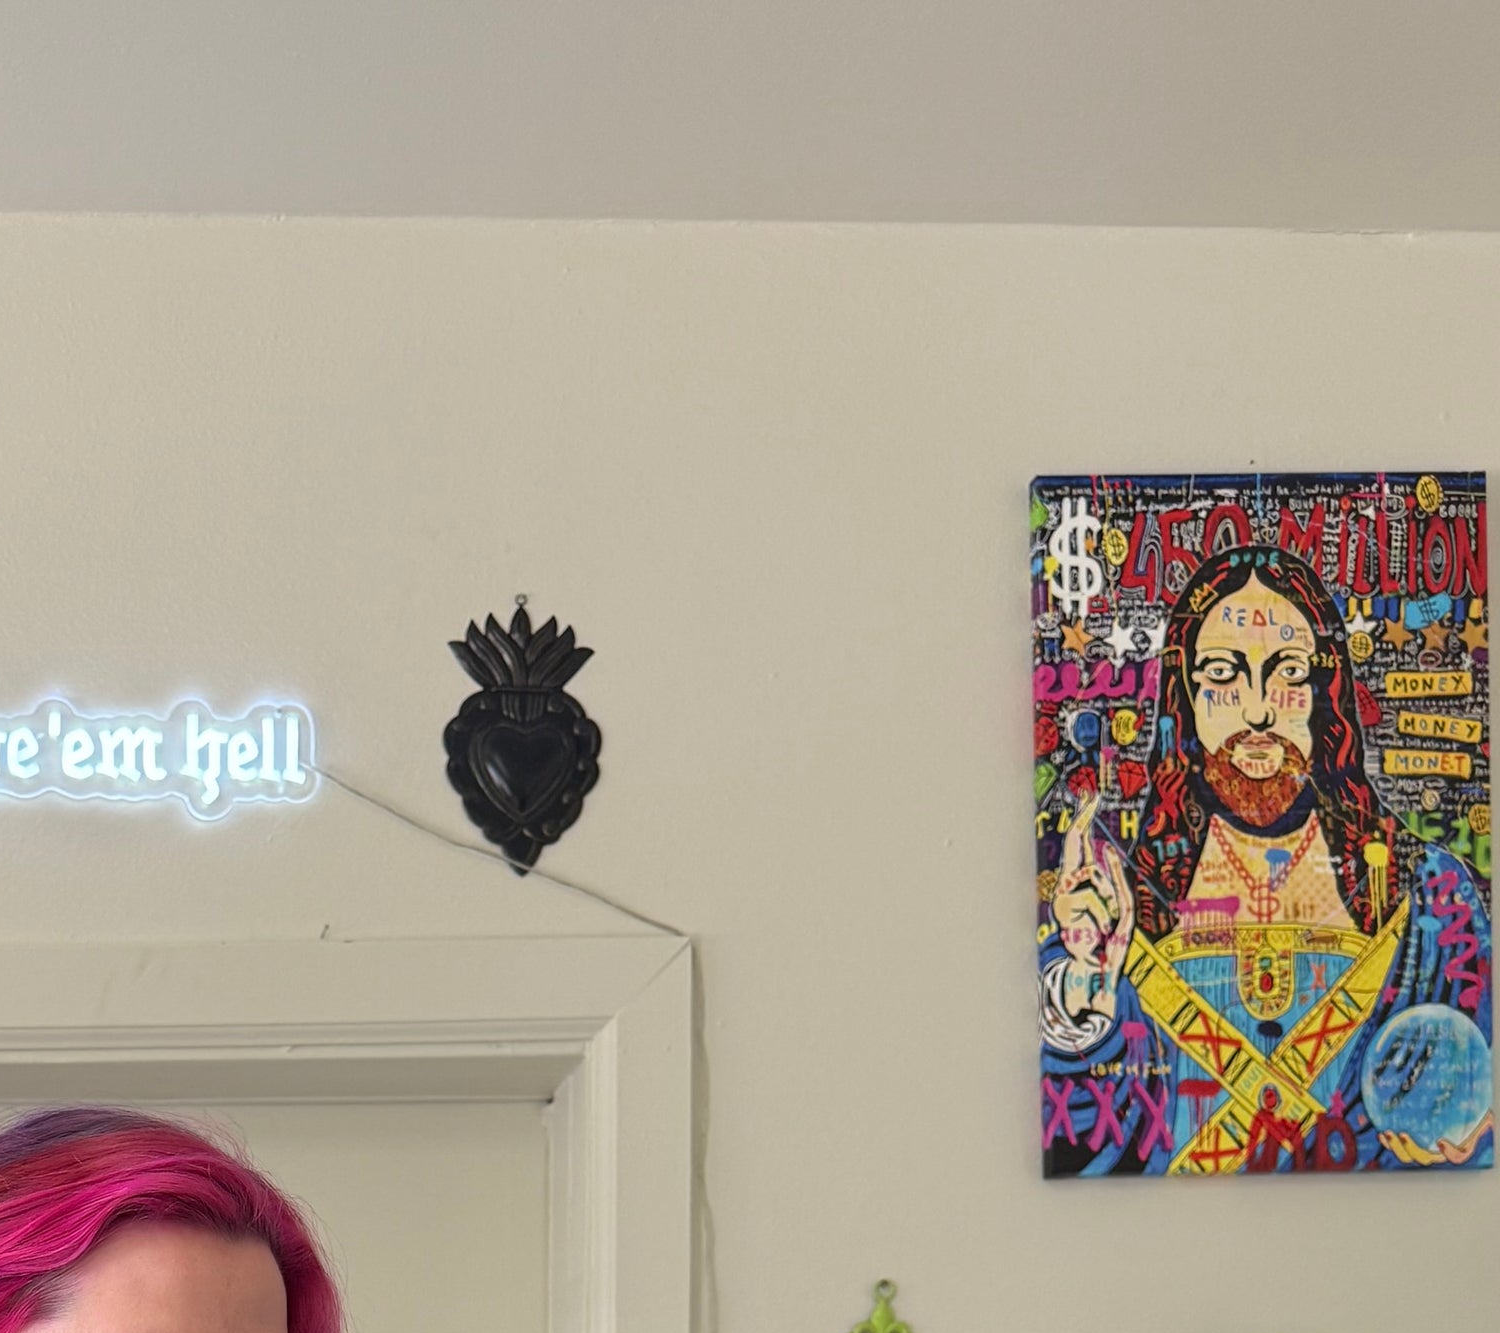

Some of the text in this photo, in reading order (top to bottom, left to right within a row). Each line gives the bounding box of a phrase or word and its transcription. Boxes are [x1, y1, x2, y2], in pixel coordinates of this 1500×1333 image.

[1279, 502, 1488, 599] MILLION
[1393, 675, 1464, 694] MONEY
[1403, 716, 1477, 739] MONEY
[180, 712, 308, 805] hell
[1394, 755, 1465, 775] MONET
